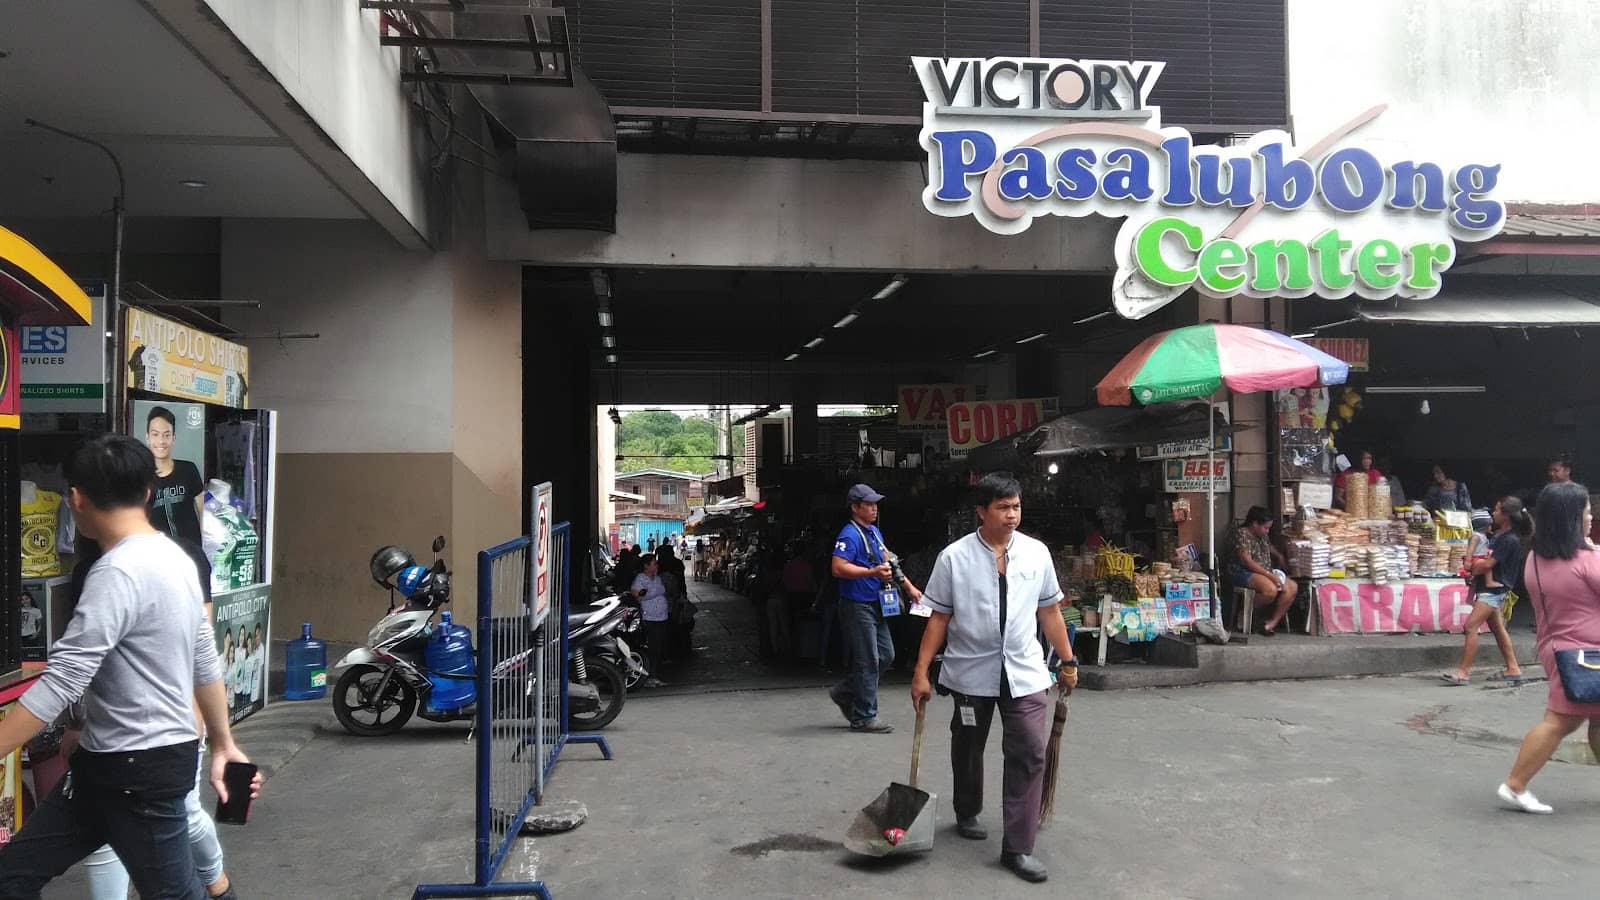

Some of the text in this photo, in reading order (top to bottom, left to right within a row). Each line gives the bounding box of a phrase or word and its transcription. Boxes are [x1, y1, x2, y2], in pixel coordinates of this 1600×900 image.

[928, 59, 1152, 110] VICTORY
[1135, 216, 1452, 292] Center
[131, 311, 248, 376] ANTIPOLO SHIRTS
[216, 599, 252, 623] ANTIPOLO
[253, 596, 268, 612] CITY
